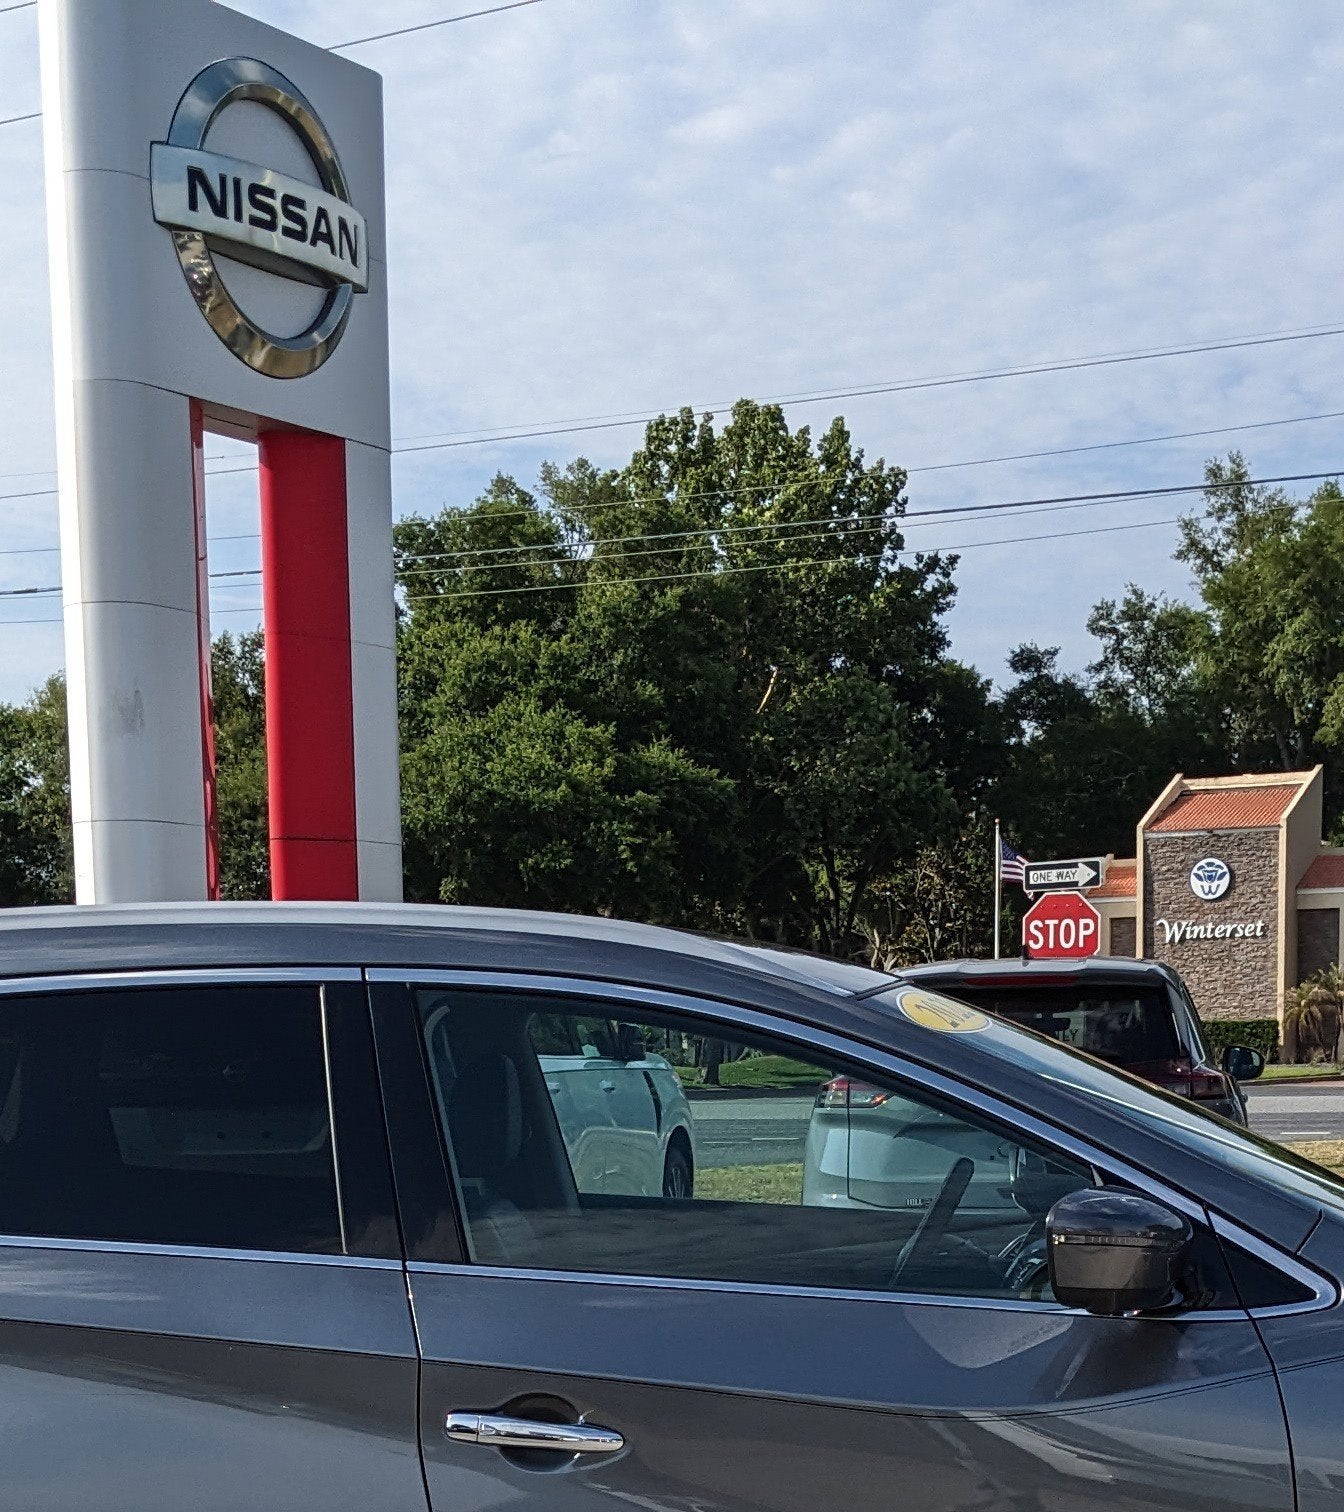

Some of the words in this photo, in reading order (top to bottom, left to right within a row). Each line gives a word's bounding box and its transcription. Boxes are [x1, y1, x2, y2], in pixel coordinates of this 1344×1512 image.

[187, 165, 359, 268] NISSAN
[1032, 872, 1053, 883] ONE
[1056, 869, 1078, 881] WAY
[1029, 918, 1095, 949] STOP
[1157, 918, 1265, 944] Winterset
